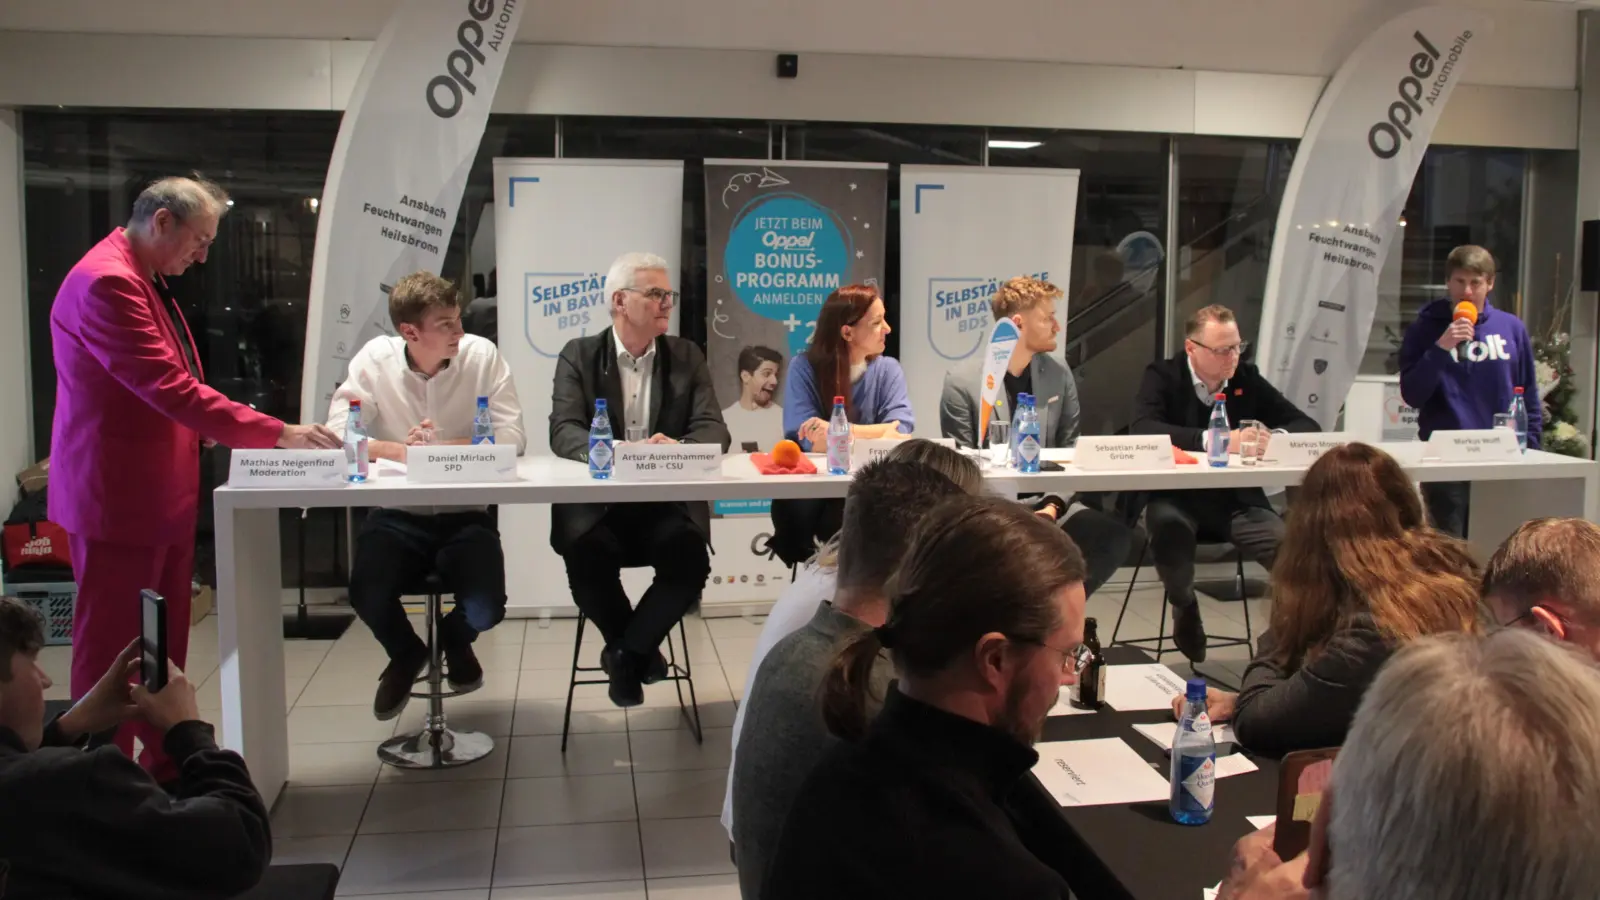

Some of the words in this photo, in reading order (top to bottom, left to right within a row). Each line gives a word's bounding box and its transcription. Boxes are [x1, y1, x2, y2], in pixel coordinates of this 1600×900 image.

[1425, 30, 1473, 107] Automobile
[1368, 30, 1441, 159] Oppel
[400, 194, 447, 219] Ansbach
[363, 202, 443, 237] Feuchtwangen
[755, 217, 788, 230] JETZT
[791, 217, 823, 230] BEIM
[381, 226, 439, 255] Heilsbronn
[762, 231, 815, 251] Oppel
[755, 252, 823, 269] BONUS-
[736, 272, 840, 289] PROGRAMM
[753, 292, 823, 305] ANMELDEN
[543, 301, 561, 317] IN
[945, 305, 962, 321] IN
[558, 311, 591, 331] BDS
[958, 315, 989, 333] BDS
[1450, 334, 1511, 363] olt
[1095, 444, 1134, 452] Sebastian
[1110, 452, 1135, 460] Grüne
[240, 459, 280, 468] Mathias
[282, 459, 335, 469] Neigenfind
[428, 454, 458, 463] Daniel
[460, 453, 496, 462] Mirlach
[622, 453, 647, 461] Artur
[649, 453, 716, 461] Auernhammer
[249, 468, 306, 477] Moderation
[444, 464, 463, 472] SPD
[636, 462, 657, 470] MdB
[666, 462, 684, 470] CSU
